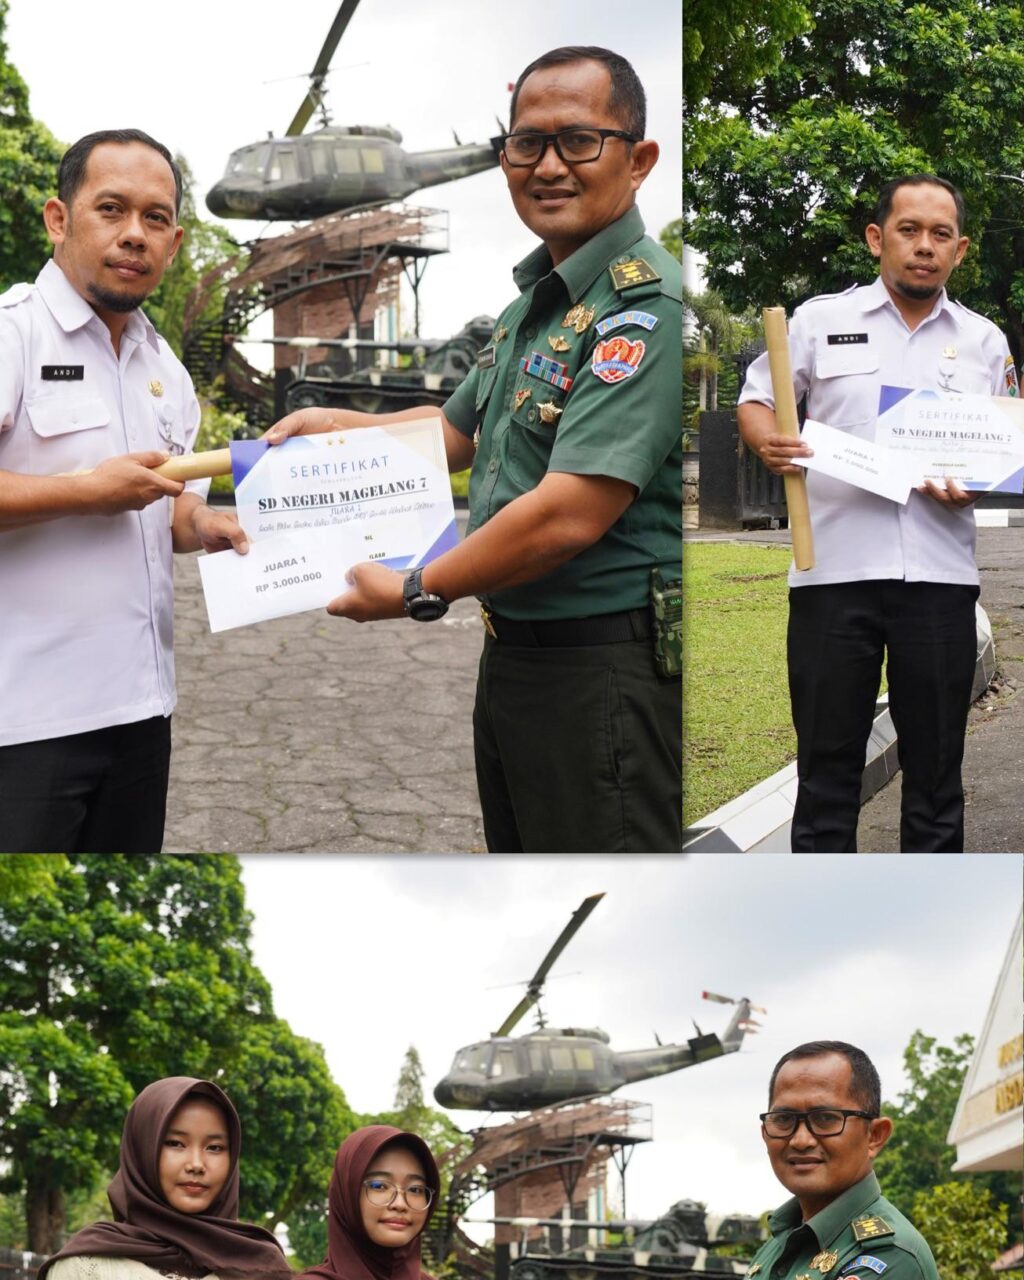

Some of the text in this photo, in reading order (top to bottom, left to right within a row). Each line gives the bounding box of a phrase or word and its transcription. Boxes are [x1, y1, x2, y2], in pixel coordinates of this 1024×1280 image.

[919, 410, 990, 423] SERTIFIKAT
[892, 427, 906, 436] SD
[909, 428, 947, 438] NEGERI
[950, 431, 1003, 441] MAGELANG
[290, 455, 390, 478] SERTIFIKAT
[258, 497, 277, 511] SD
[281, 491, 335, 508] NEGERI
[339, 479, 416, 503] MAGELANG
[419, 477, 427, 489] 7
[263, 556, 307, 573] JUARA 1
[255, 571, 322, 593] RP 3.000.000
